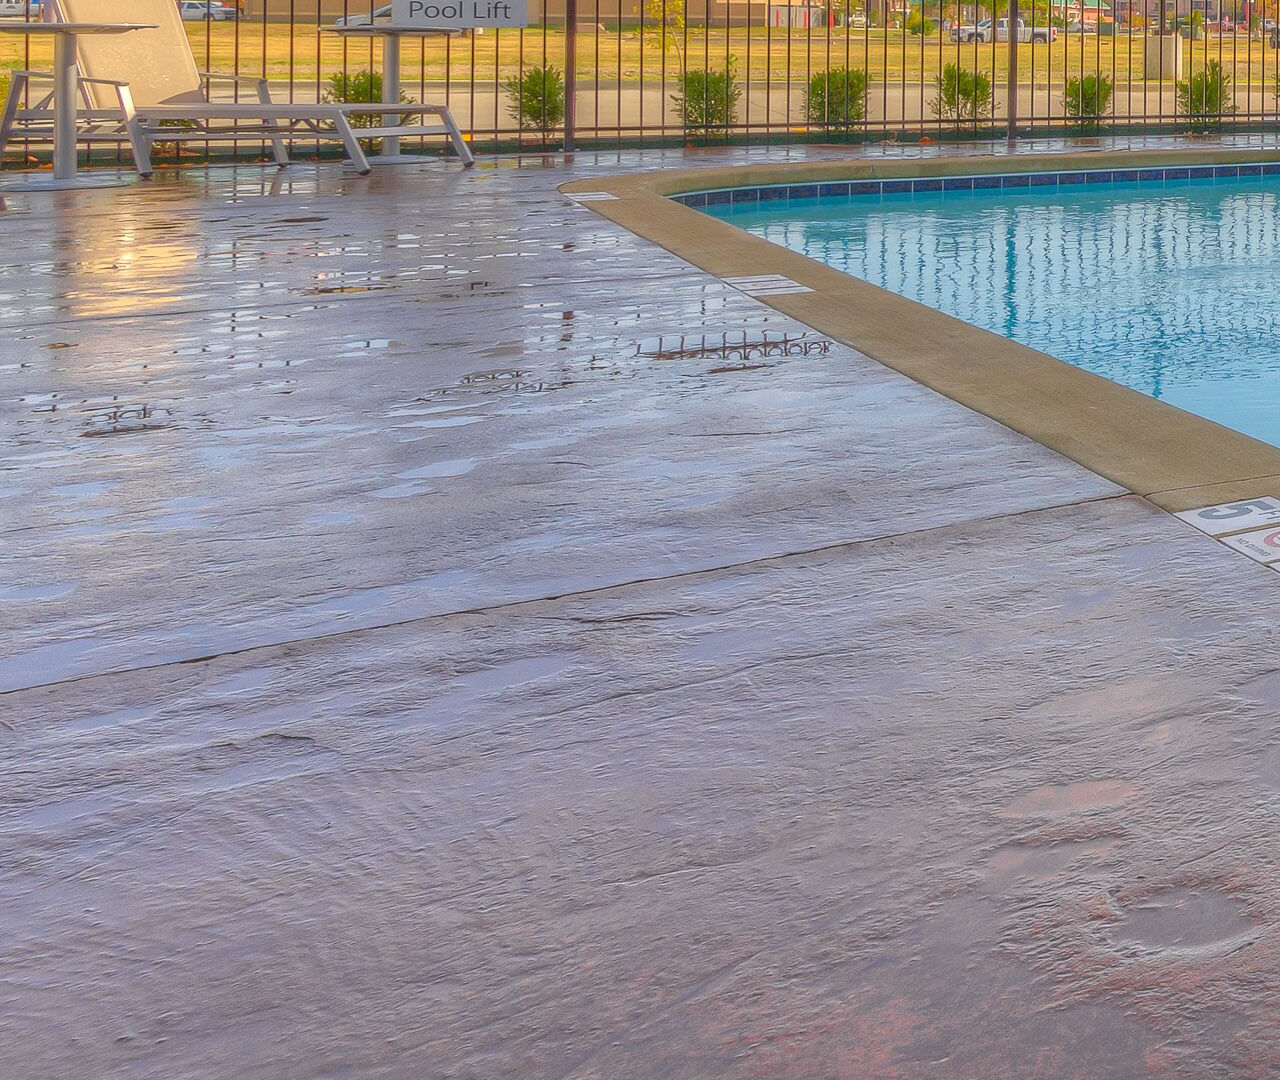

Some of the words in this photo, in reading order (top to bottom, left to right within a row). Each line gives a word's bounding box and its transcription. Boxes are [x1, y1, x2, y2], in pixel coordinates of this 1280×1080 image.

[409, 1, 463, 19] Pool
[473, 1, 511, 19] Lift
[1197, 500, 1277, 520] 5
